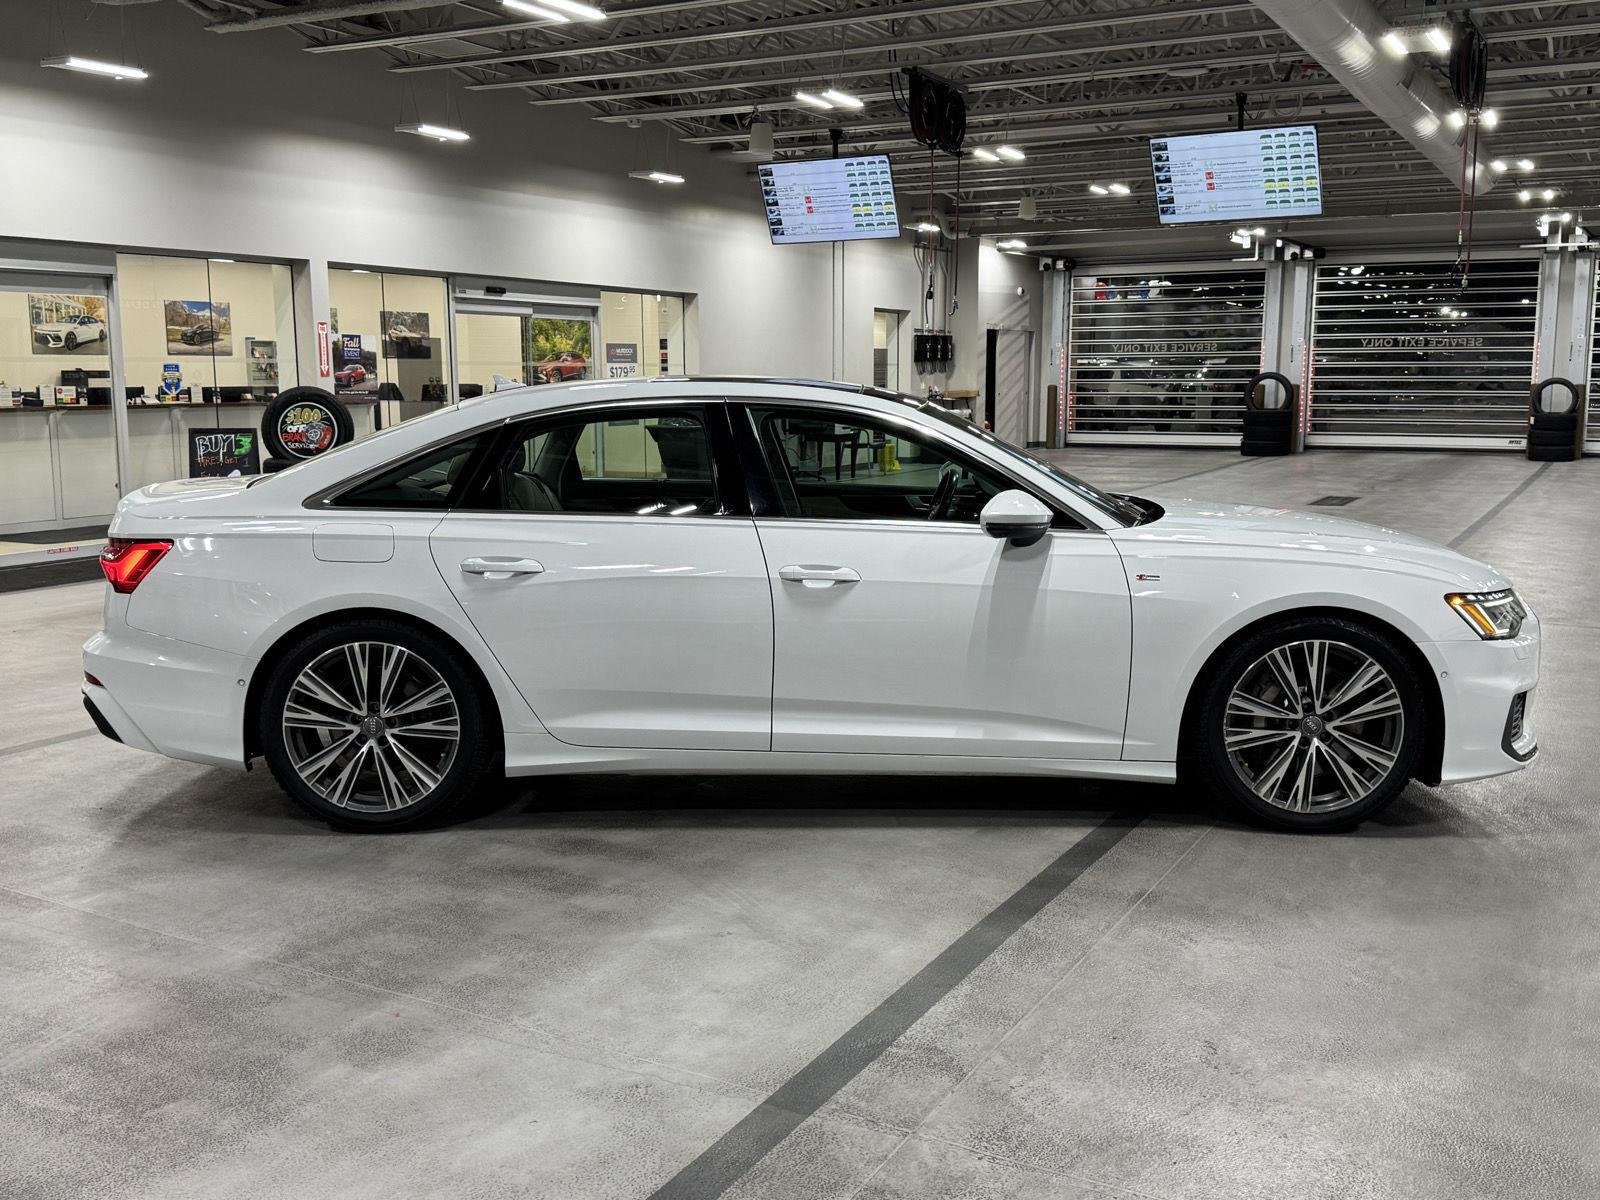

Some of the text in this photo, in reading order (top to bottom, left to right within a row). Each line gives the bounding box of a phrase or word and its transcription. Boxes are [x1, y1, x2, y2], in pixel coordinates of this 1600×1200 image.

[343, 337, 360, 348] Fall
[285, 407, 321, 425] $100
[287, 424, 307, 433] OFF
[196, 433, 253, 456] BUY 3
[224, 456, 239, 464] GET
